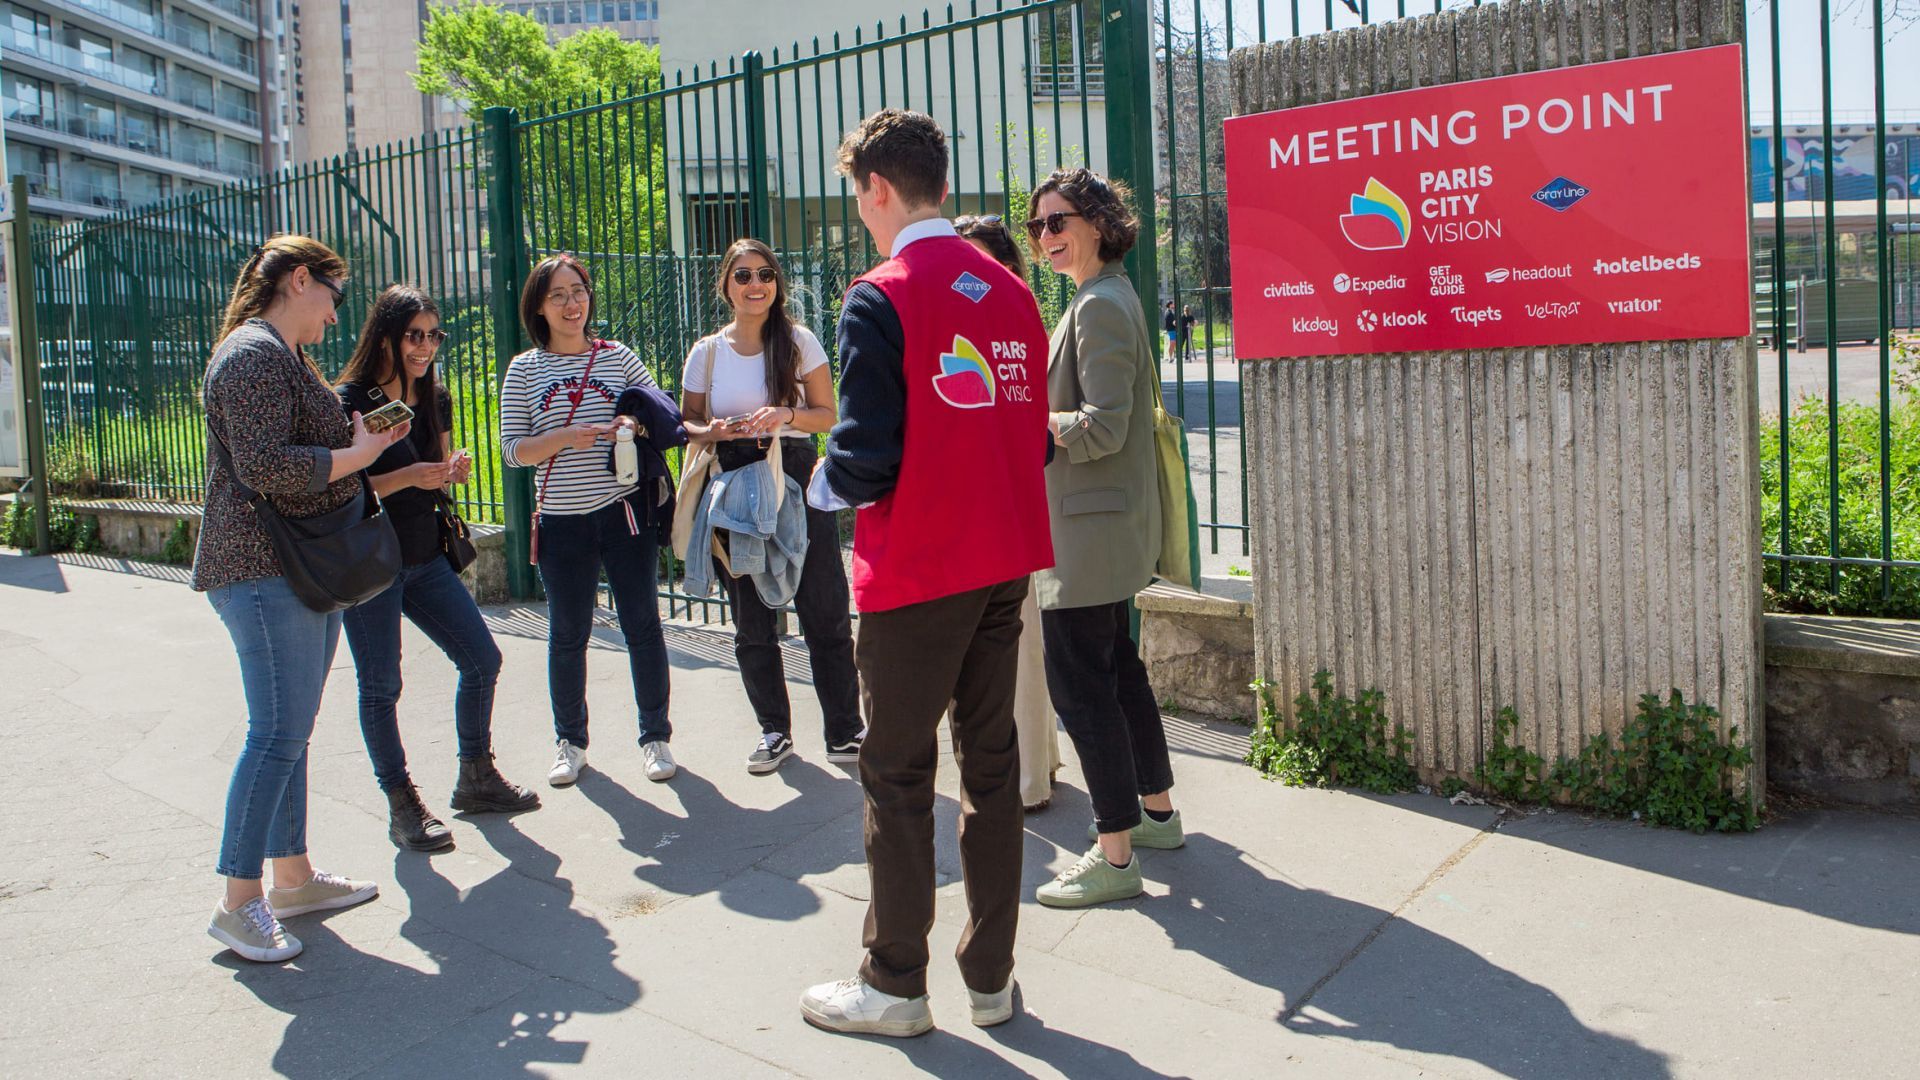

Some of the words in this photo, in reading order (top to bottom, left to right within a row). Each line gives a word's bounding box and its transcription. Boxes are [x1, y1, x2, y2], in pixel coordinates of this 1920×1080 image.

[1269, 110, 1478, 169] MEETING
[1502, 84, 1673, 140] POINT
[1419, 165, 1493, 194] PARIS
[1420, 193, 1479, 219] CITY
[1422, 218, 1502, 244] VISION
[1429, 265, 1451, 276] GET
[1512, 264, 1573, 281] headout
[1593, 252, 1702, 275] hotelbeds
[1264, 281, 1315, 298] civitatis
[1352, 274, 1406, 295] Expedia
[1430, 275, 1463, 285] YOUR
[1430, 285, 1465, 296] GUIDE
[1292, 316, 1338, 337] kkday
[1382, 310, 1428, 327] klook
[1450, 306, 1502, 327] Tiqets
[1607, 298, 1662, 313] viator
[563, 375, 579, 389] DE
